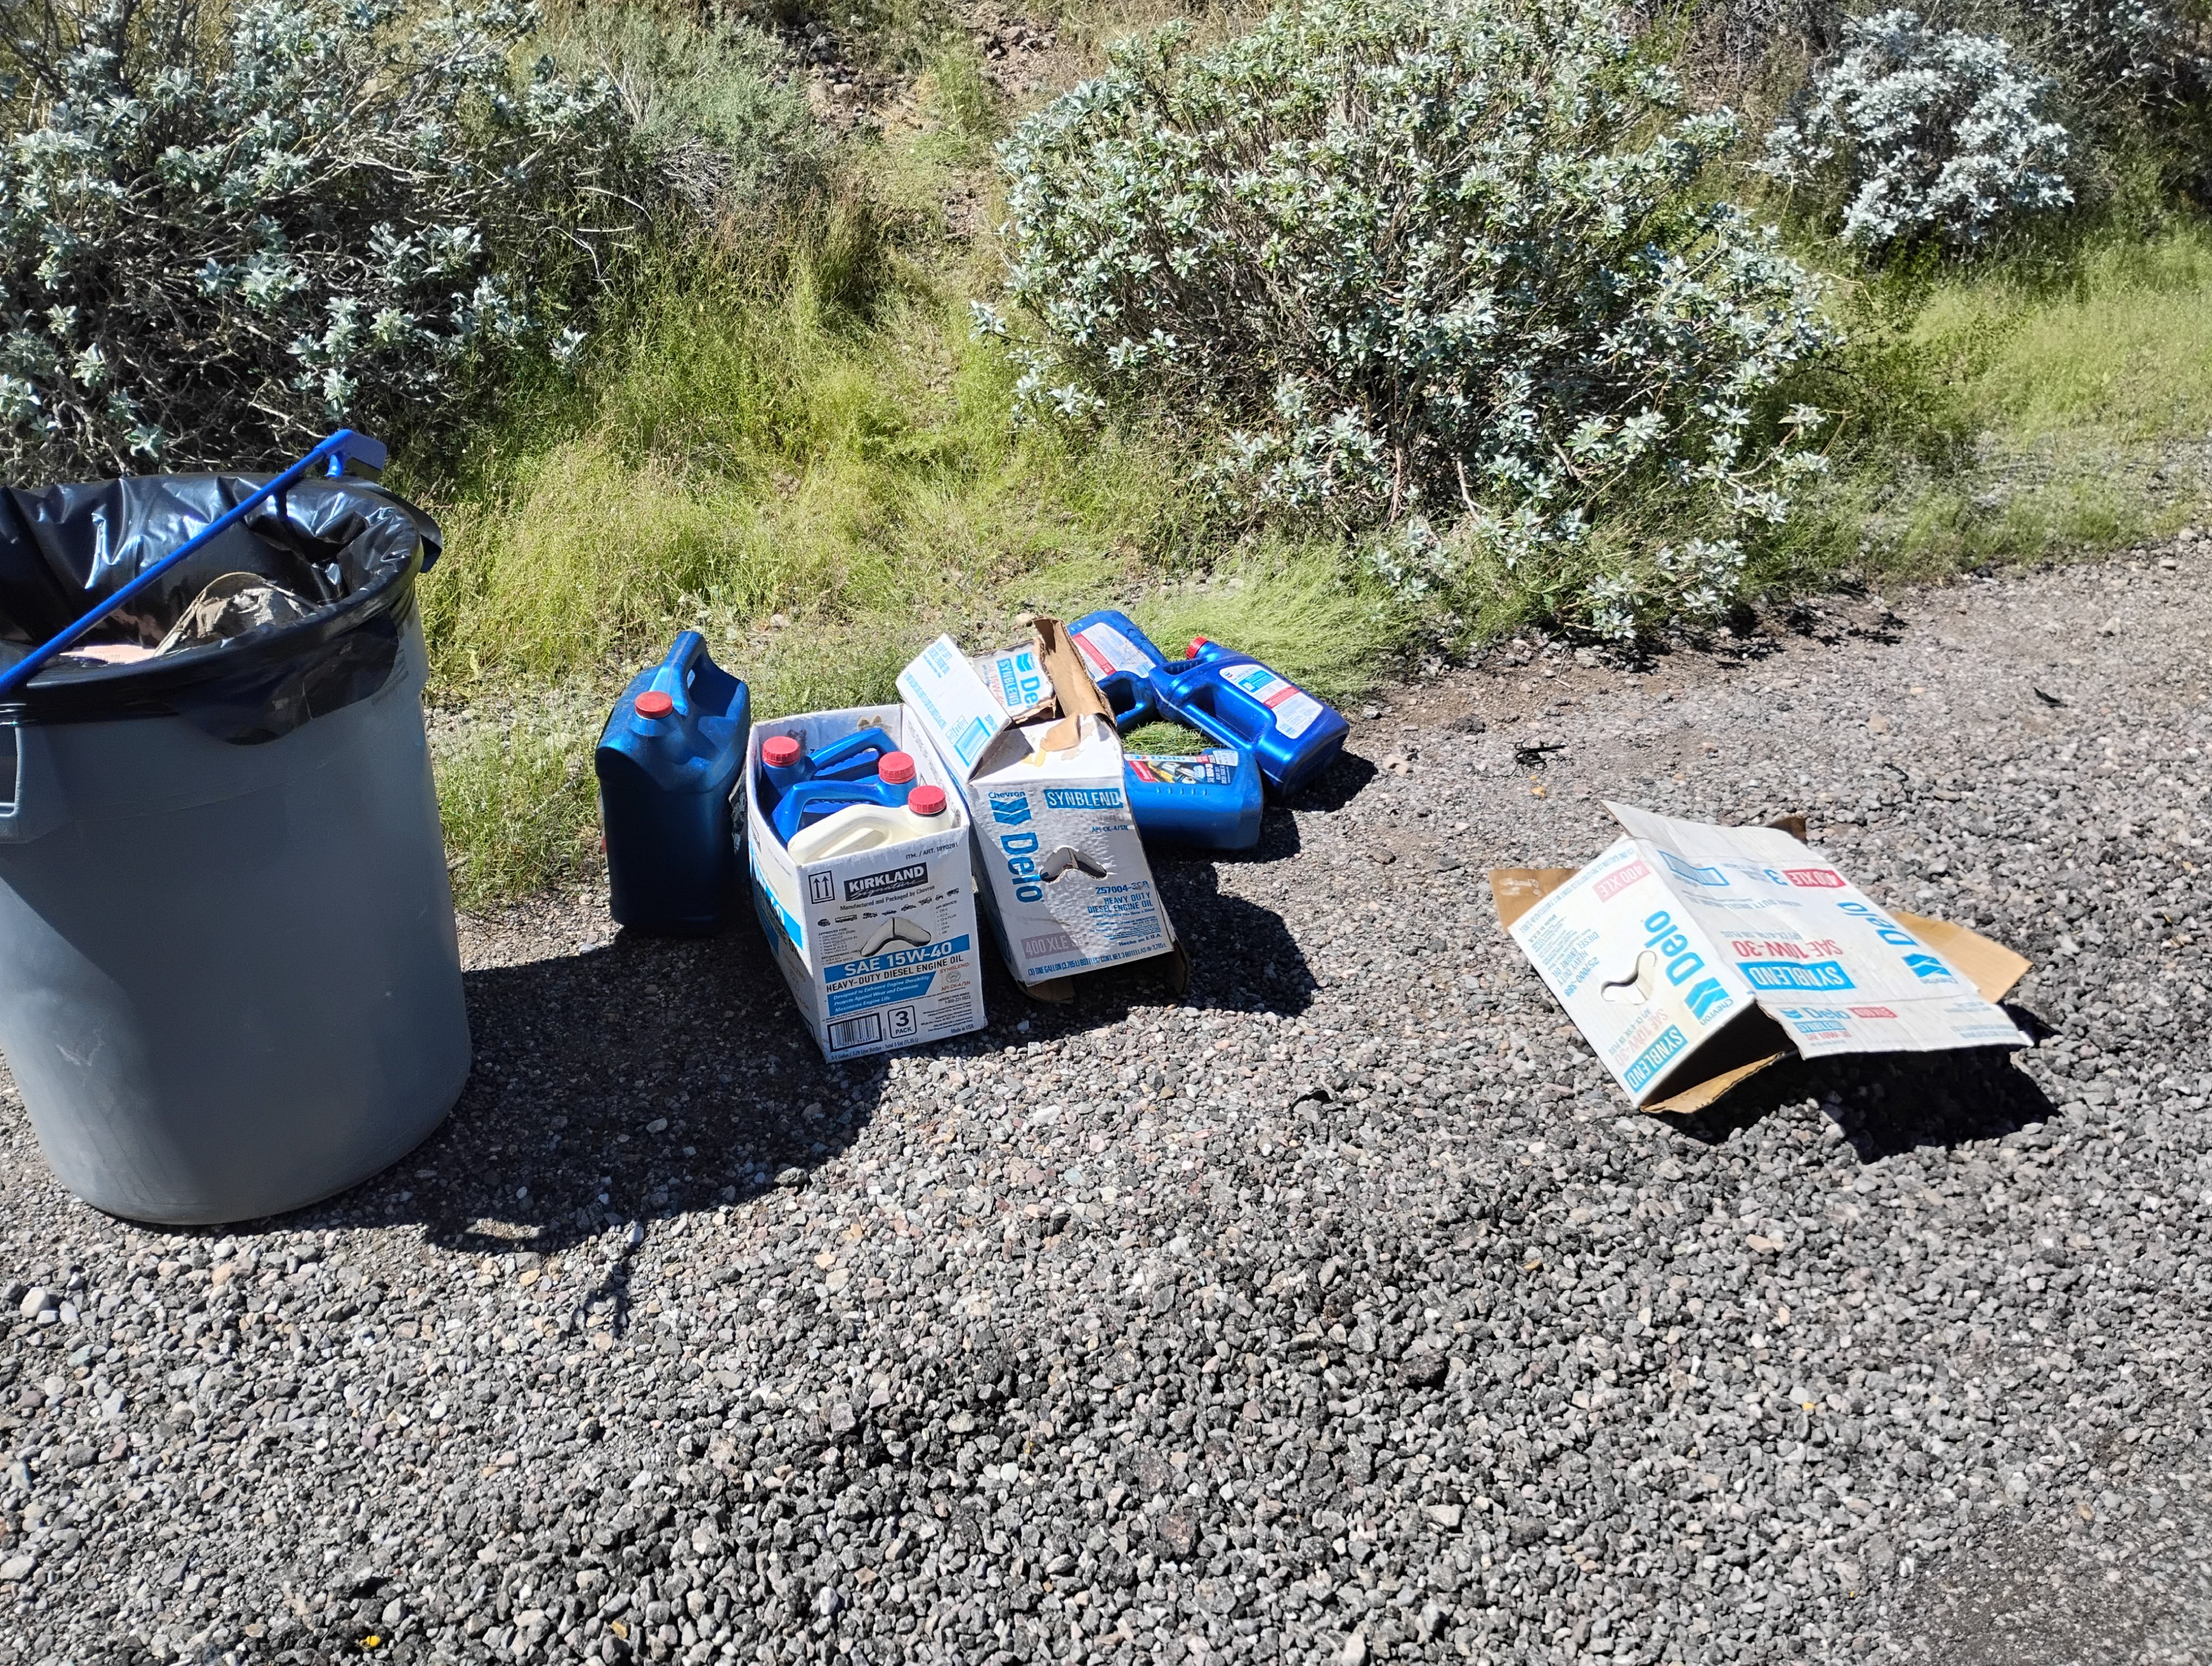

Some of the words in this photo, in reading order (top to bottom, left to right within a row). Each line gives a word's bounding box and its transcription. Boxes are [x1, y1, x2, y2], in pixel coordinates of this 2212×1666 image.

[999, 658, 1020, 706] SYNBLEND
[987, 790, 1026, 798] Chevron
[1047, 791, 1121, 806] SYNBLEND
[905, 851, 917, 860] ITM.
[922, 847, 935, 856] ART.
[936, 841, 958, 853] 1890281
[1000, 832, 1045, 902] Delo
[1618, 862, 1645, 885] 400
[1763, 869, 1788, 886] 3
[848, 866, 924, 893] KIRKLAND
[849, 874, 925, 901] Signature
[1596, 874, 1623, 898] XLE
[1791, 873, 1818, 885] XLE
[839, 899, 874, 912] Manufactured
[885, 892, 908, 903] Packaged
[908, 890, 916, 898] by
[916, 885, 935, 895] Chevron
[1088, 905, 1112, 913] DIESEL
[1113, 902, 1140, 912] ENGINE
[1141, 899, 1153, 908] OIL
[1104, 895, 1128, 905] HEAVY
[1130, 892, 1150, 902] DUTY
[1752, 899, 1777, 909] DUTY
[1837, 901, 1919, 947] Delo
[1024, 938, 1047, 956] 400
[1045, 934, 1069, 952] XLE
[1575, 930, 1600, 951] DIESEL
[1643, 909, 1706, 986] Delo
[1731, 940, 1809, 959] 10W-30
[1807, 939, 1844, 956] SAE
[844, 957, 881, 977] SAE
[886, 940, 953, 967] 15W-40
[939, 962, 969, 974] SYNBLEND
[1043, 963, 1062, 973] GALLON
[1558, 946, 1578, 970] ENGINE
[1569, 949, 1589, 971] HEAVY
[826, 972, 881, 993] HEAVY-DUTY
[883, 965, 914, 979] DIESEL
[916, 958, 946, 972] ENGINE
[949, 953, 963, 964] OIL
[1551, 966, 1562, 979] OIL
[1555, 967, 1573, 987] DUTY
[1748, 965, 1844, 986] SYNBLEND
[833, 990, 857, 1001] Designed
[864, 983, 886, 993] Enhance
[886, 979, 903, 989] Engine
[903, 975, 930, 984] Durability
[833, 997, 853, 1007] Protects
[853, 992, 872, 1003] Against
[873, 990, 885, 998] Wear
[896, 983, 918, 992] Corrosion
[834, 1002, 862, 1013] Maximizes
[863, 997, 880, 1007] Engine
[1700, 997, 1733, 1026] Chevron
[1801, 1007, 1851, 1020] Delo
[893, 1008, 910, 1028] 3
[1647, 1006, 1668, 1030] SAE
[1795, 1021, 1846, 1033] SYNBLEND
[895, 1025, 912, 1035] PACK
[1613, 1024, 1652, 1068] 10W-30
[1629, 1029, 1683, 1090] SYNBLEND
